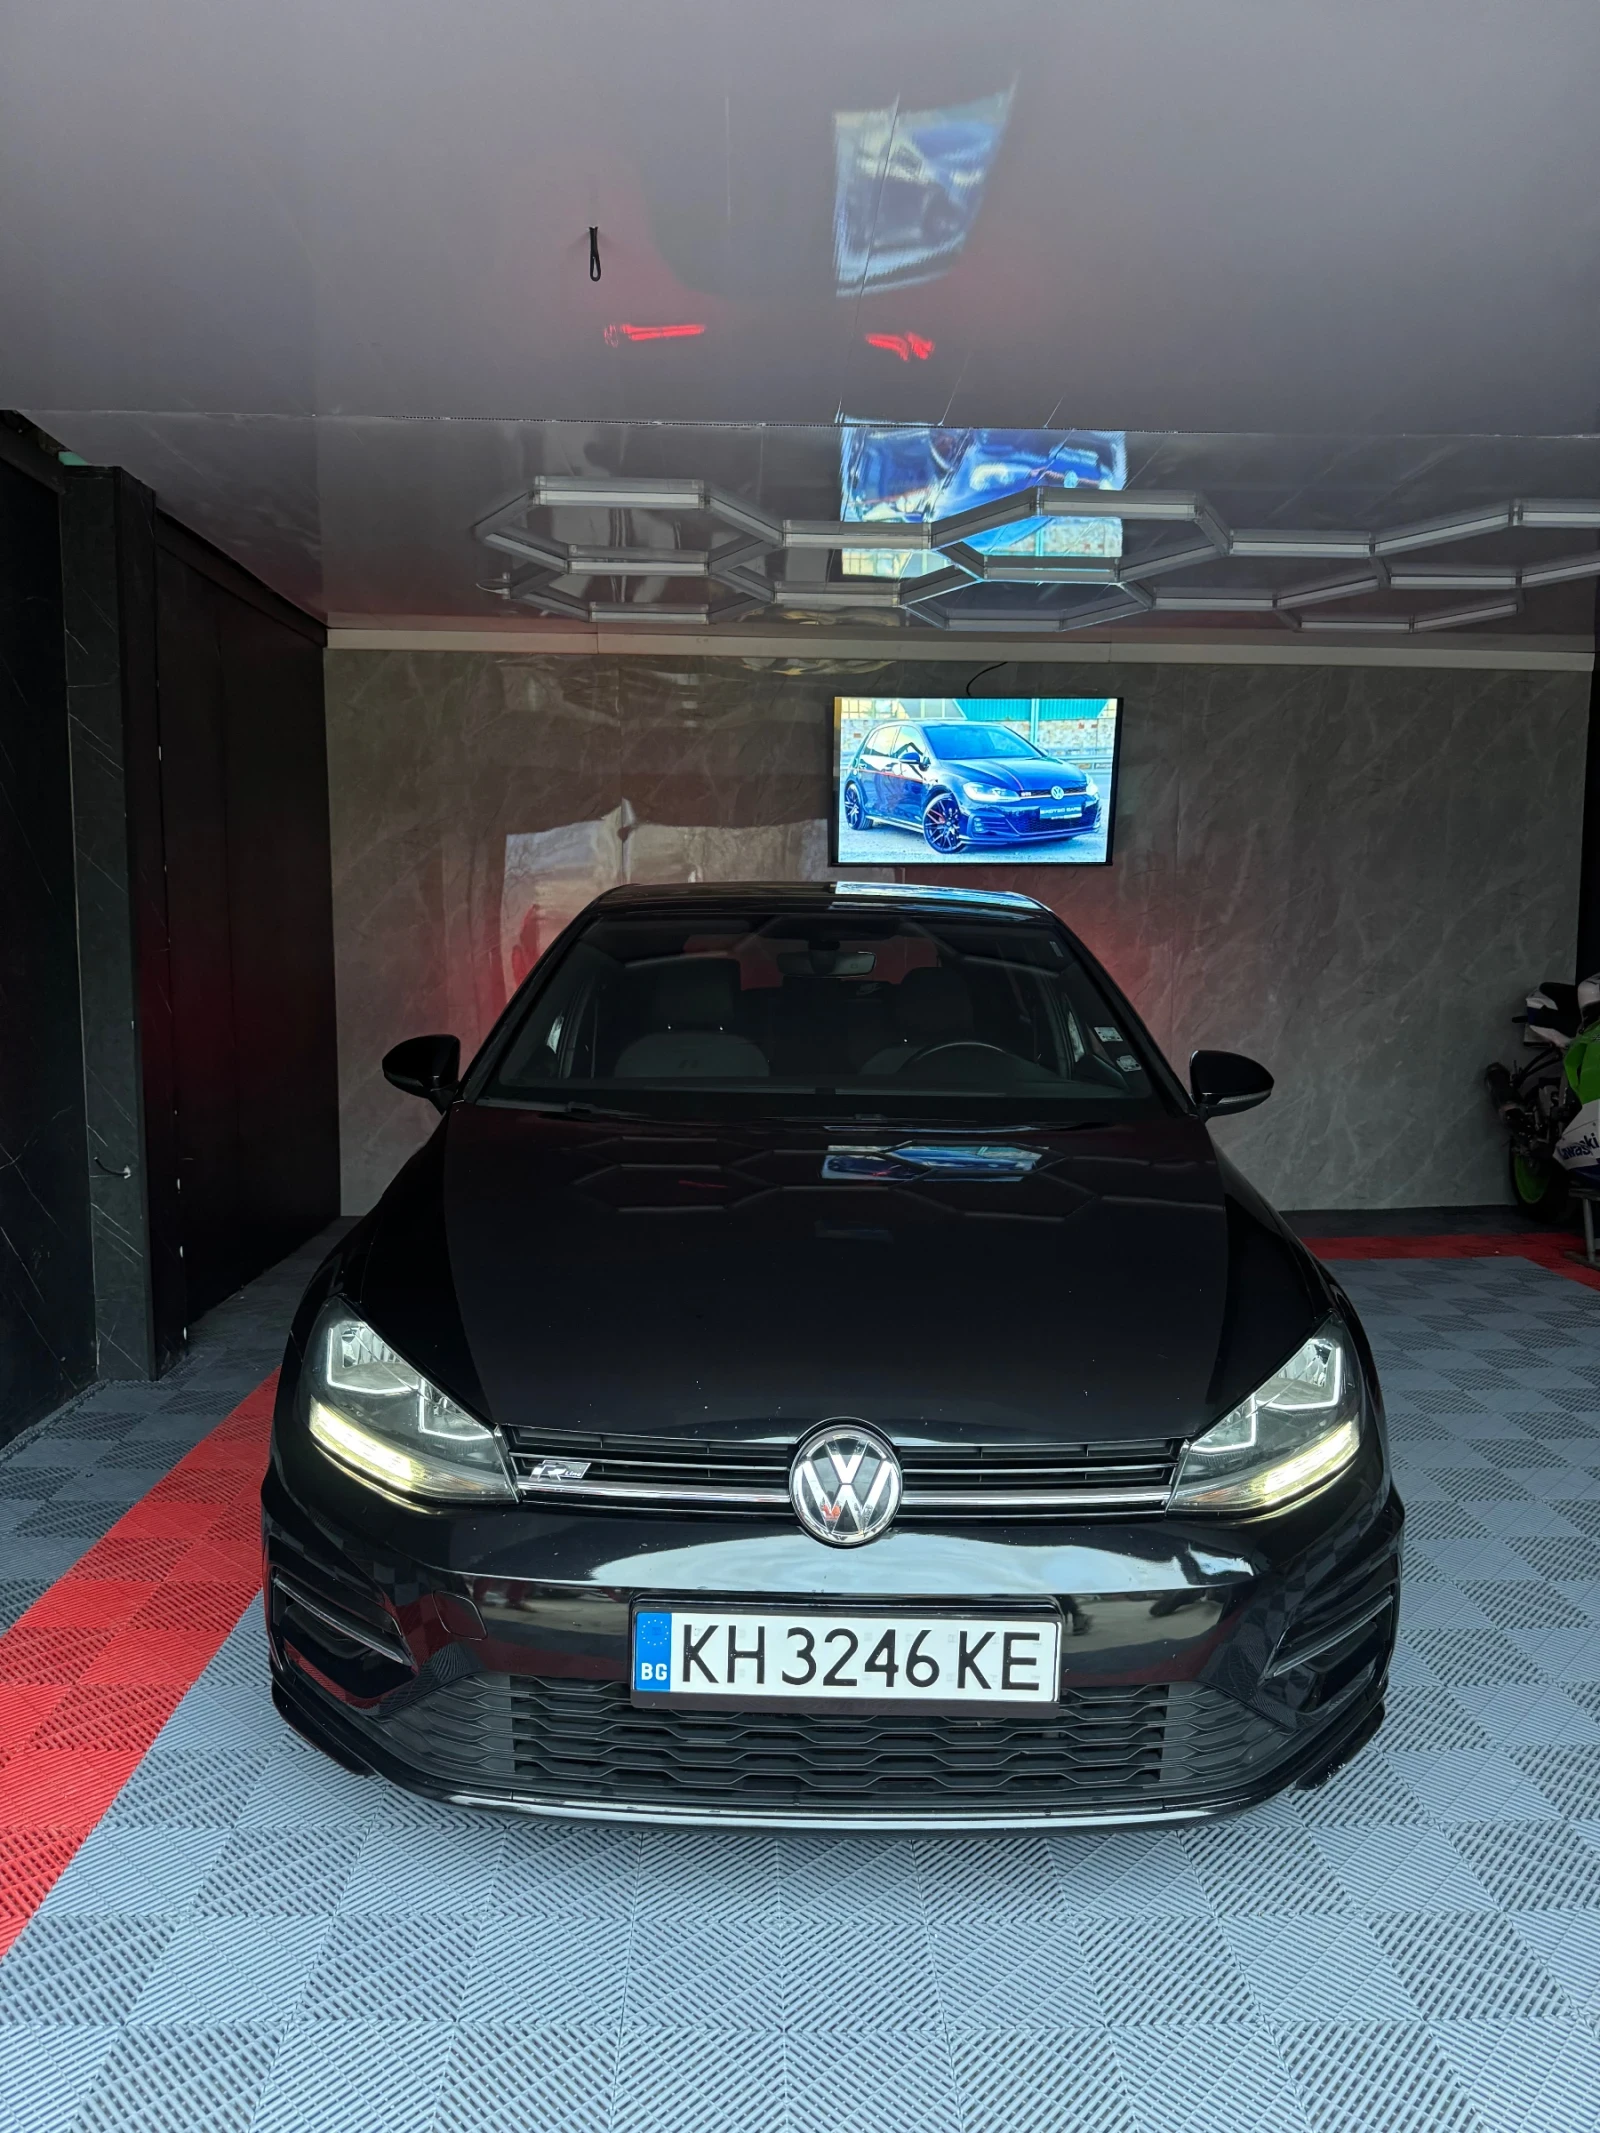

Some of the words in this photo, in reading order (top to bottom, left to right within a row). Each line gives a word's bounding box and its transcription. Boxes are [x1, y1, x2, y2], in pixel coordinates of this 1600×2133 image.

[641, 1662, 668, 1681] BG
[682, 1624, 765, 1684] KH
[782, 1626, 940, 1688] 3246
[957, 1630, 1040, 1691] KE
